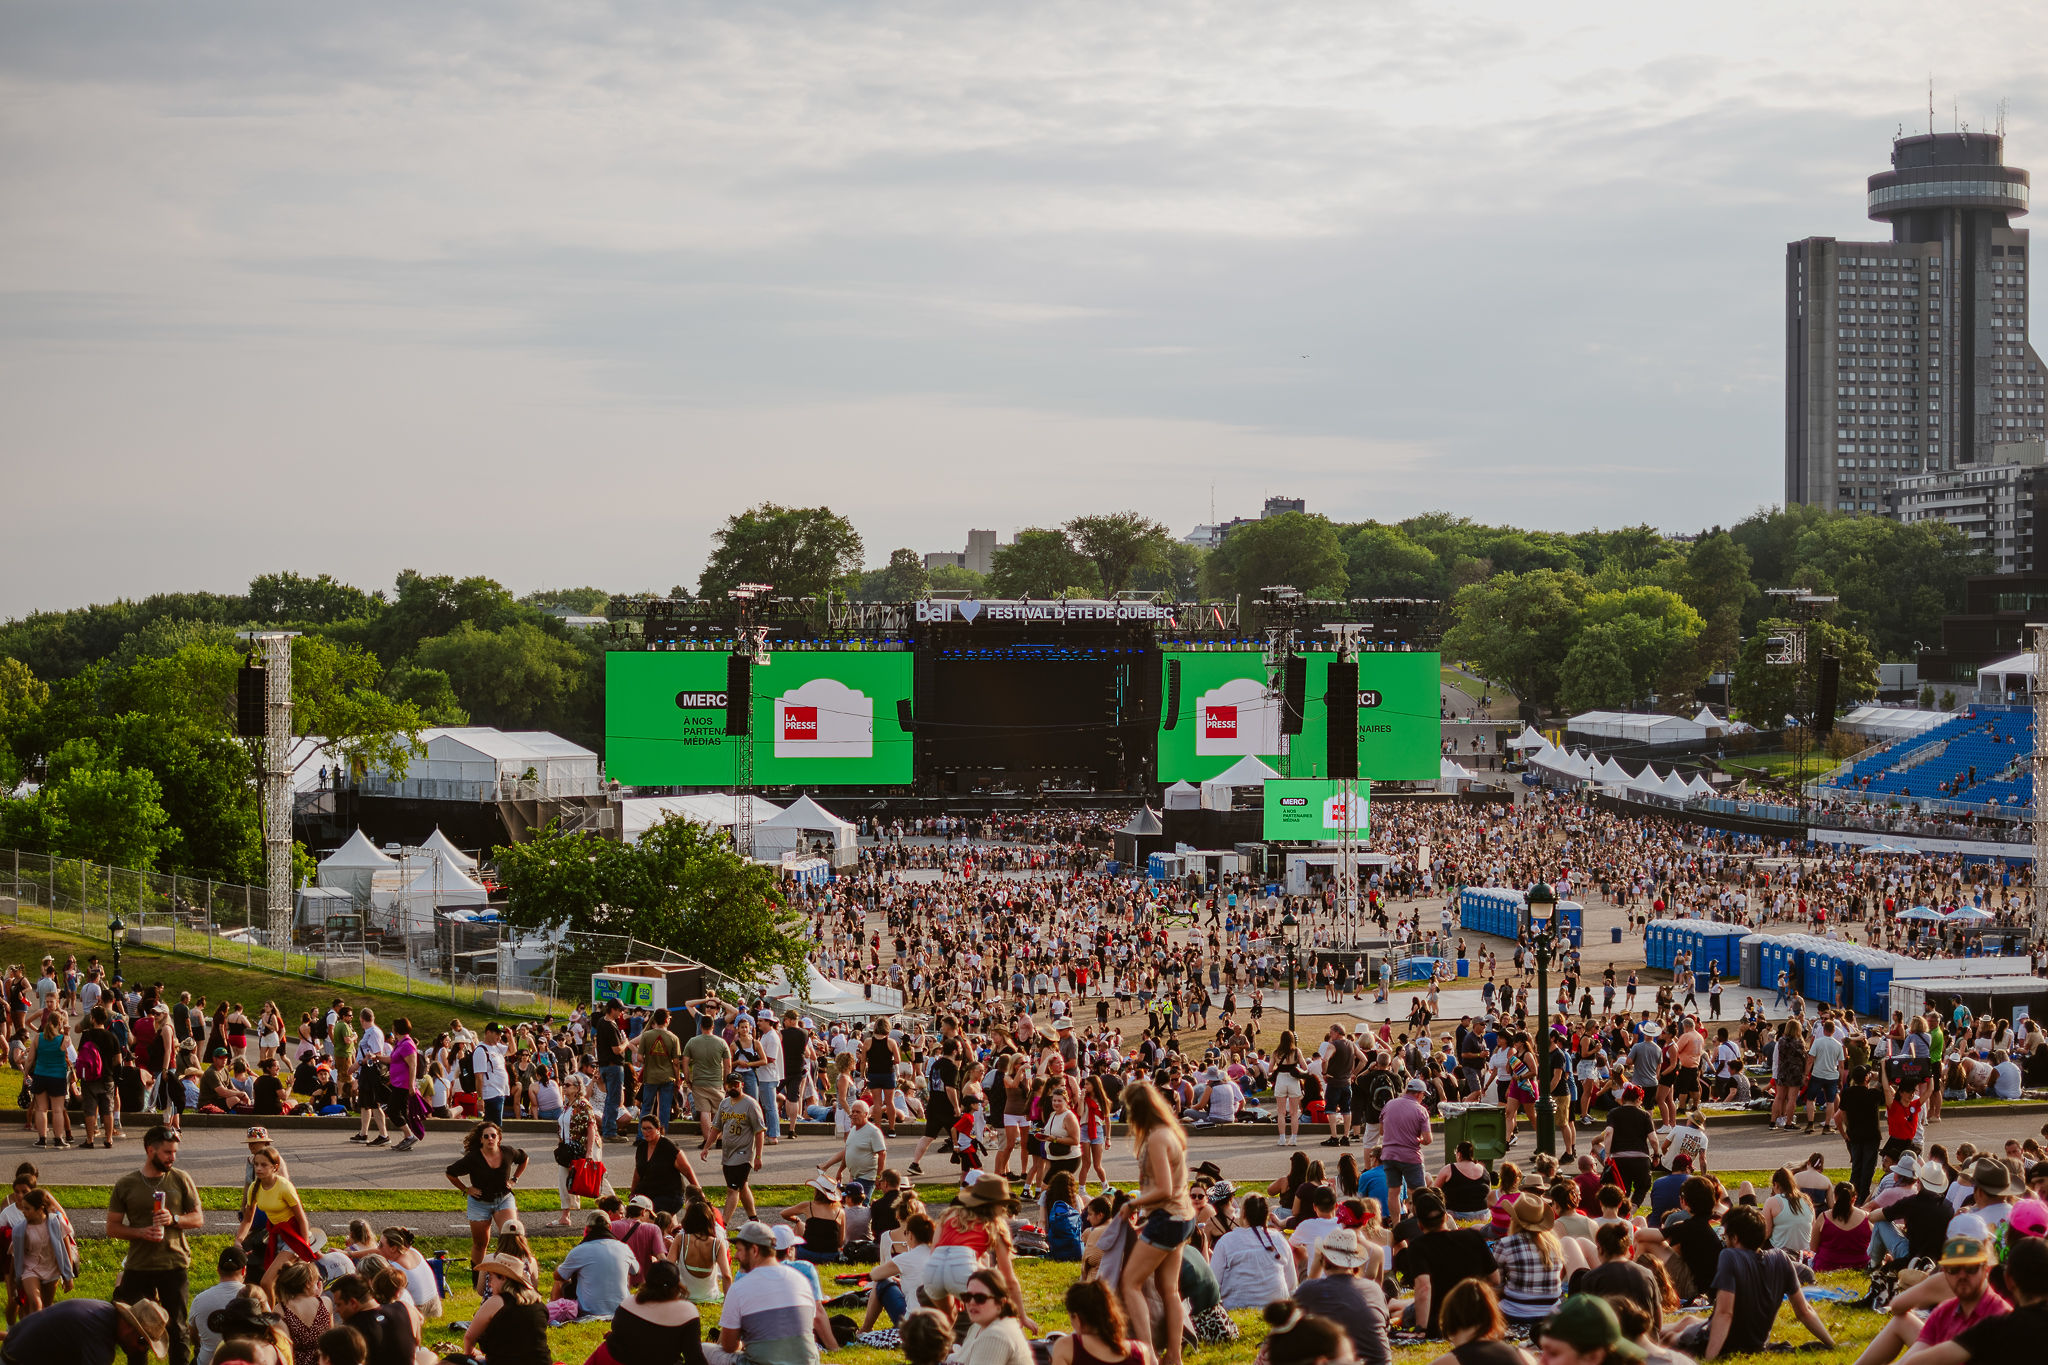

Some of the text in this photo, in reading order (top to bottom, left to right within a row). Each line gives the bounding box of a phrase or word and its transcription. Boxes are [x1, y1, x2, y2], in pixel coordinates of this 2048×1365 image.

[915, 600, 952, 622] Bell
[987, 606, 1051, 620] FESTIVAL
[1096, 607, 1115, 619] DE
[683, 693, 727, 706] MERC
[683, 715, 713, 725] À NOS
[785, 713, 797, 722] LA
[1207, 713, 1218, 721] LA
[785, 721, 816, 730] PRESSE
[1207, 720, 1236, 729] PRESSE
[1359, 725, 1392, 733] NAIRES
[683, 727, 727, 736] PARTENA
[683, 736, 721, 746] MÉDIAS
[639, 988, 650, 996] FEQ
[729, 1125, 742, 1136] 30
